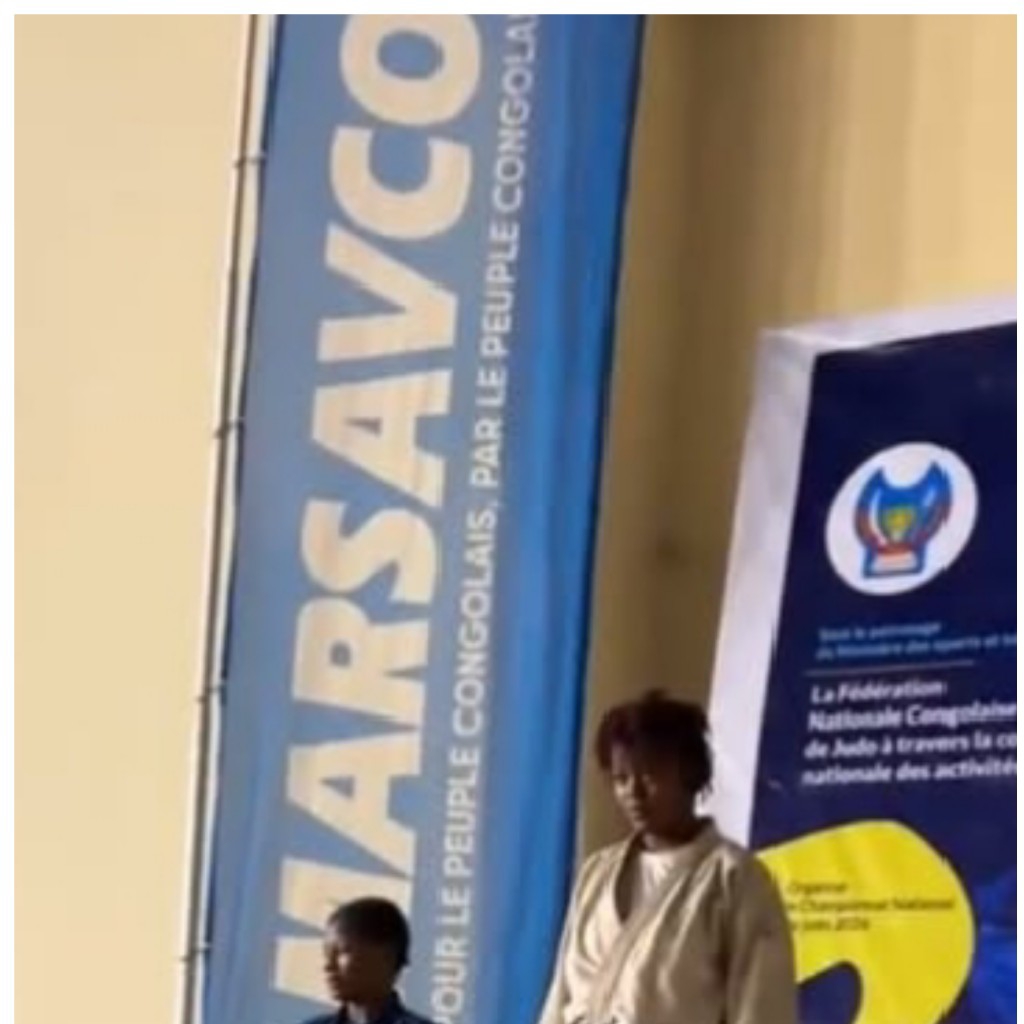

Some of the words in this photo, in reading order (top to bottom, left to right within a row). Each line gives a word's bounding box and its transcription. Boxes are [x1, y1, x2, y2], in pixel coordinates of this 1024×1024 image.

[479, 221, 520, 357] PEUPLE
[475, 366, 509, 408] LE
[469, 417, 503, 488] PAR
[811, 684, 834, 704] La
[808, 706, 901, 731] Nationale
[804, 739, 829, 759] de
[896, 736, 970, 753] travers
[973, 731, 992, 749] la
[801, 763, 892, 785] nationale
[896, 760, 930, 781] des
[442, 746, 482, 878] PEUPLE
[434, 887, 471, 926] LE
